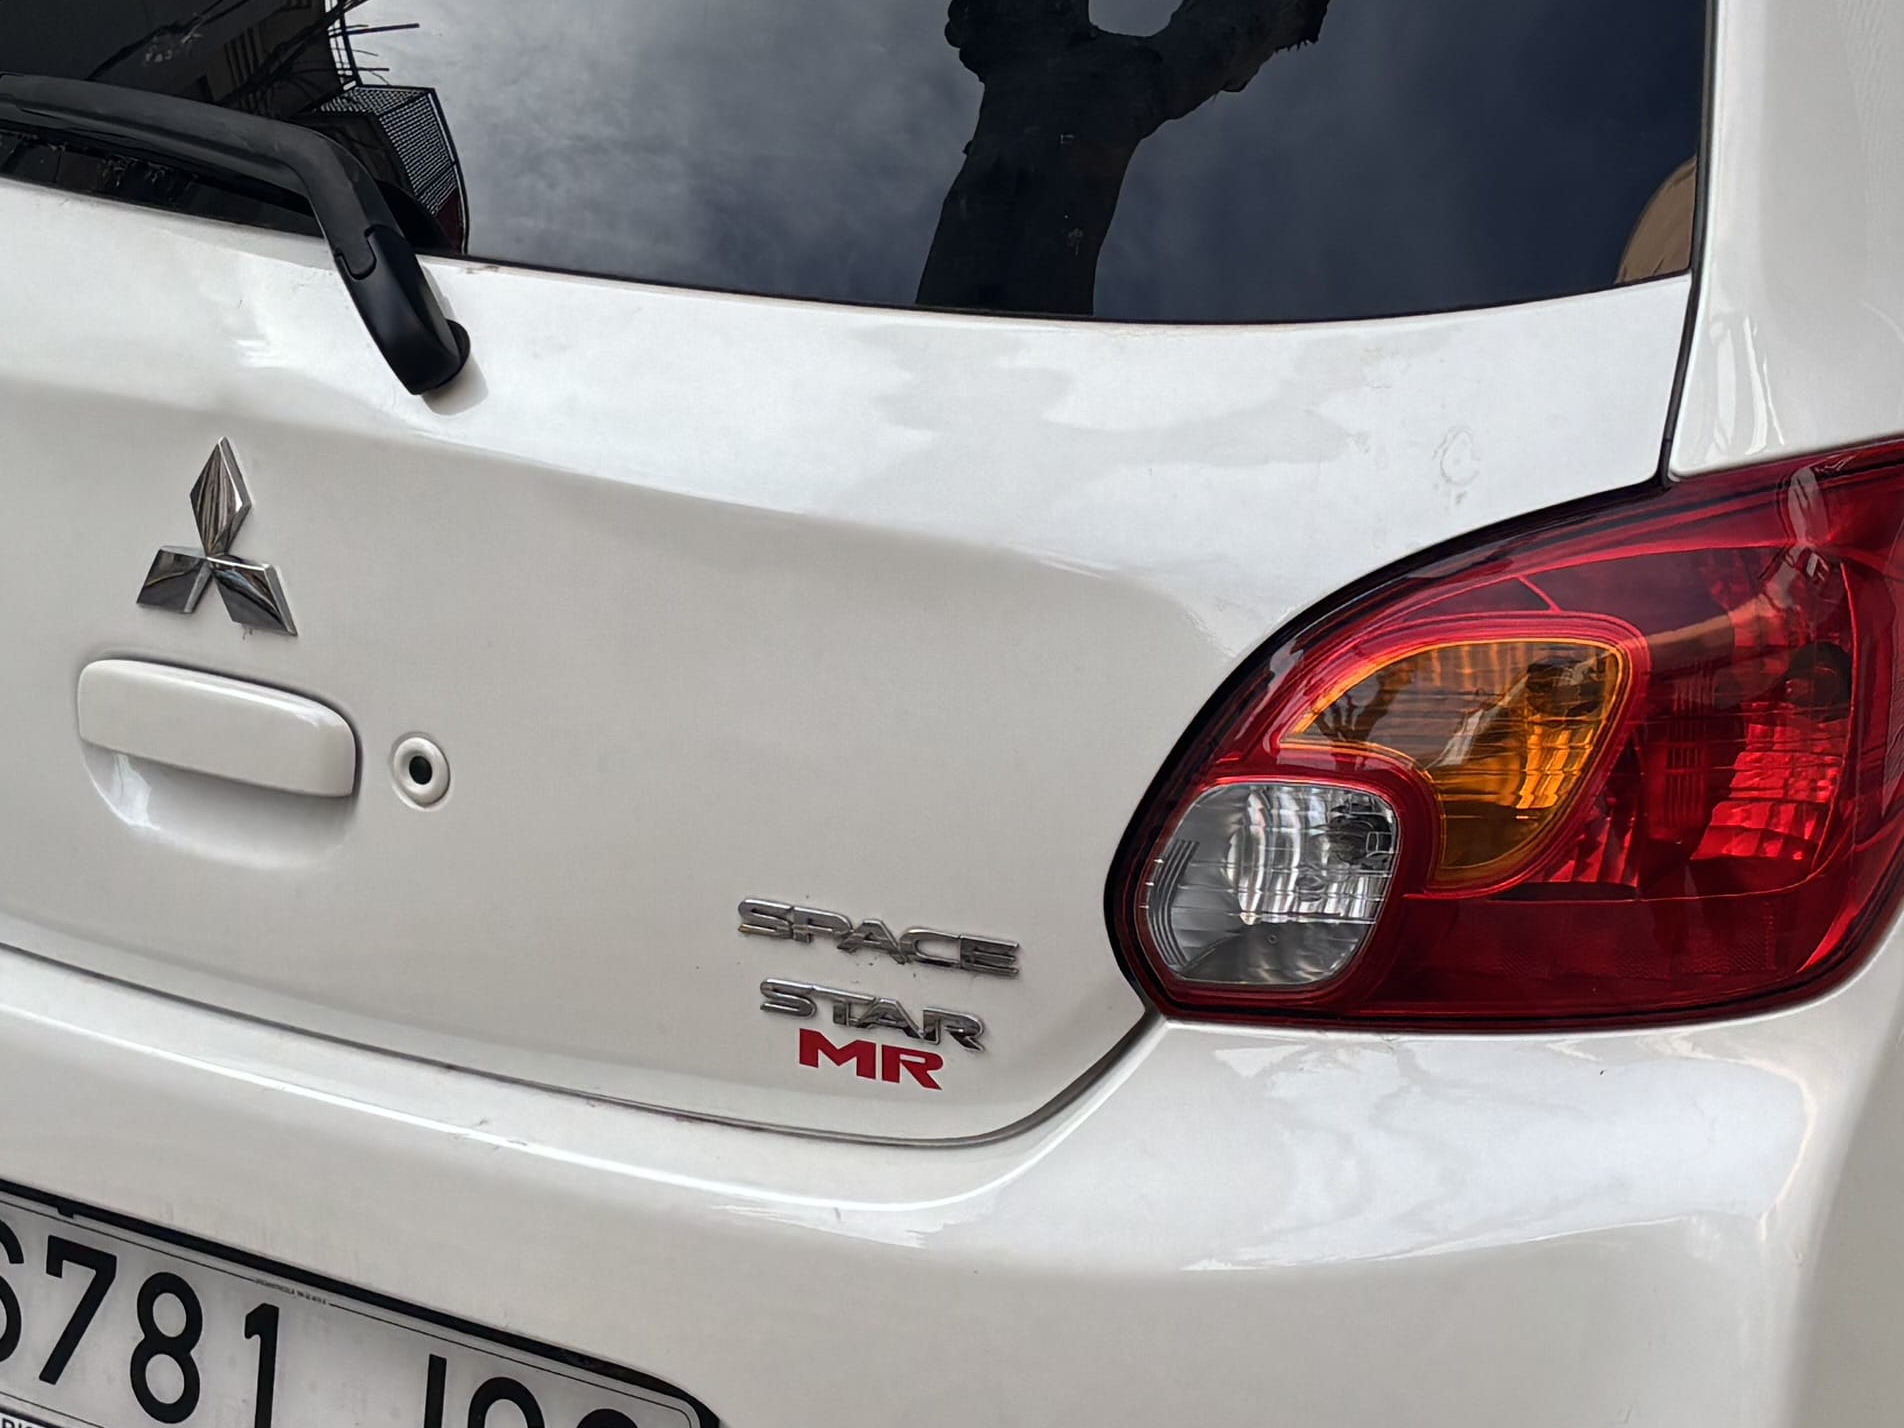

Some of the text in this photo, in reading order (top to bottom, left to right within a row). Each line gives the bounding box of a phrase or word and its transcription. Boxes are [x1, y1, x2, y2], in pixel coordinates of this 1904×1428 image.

[737, 897, 1020, 976] SPACE
[759, 978, 985, 1052] STAR
[799, 1028, 944, 1091] MR
